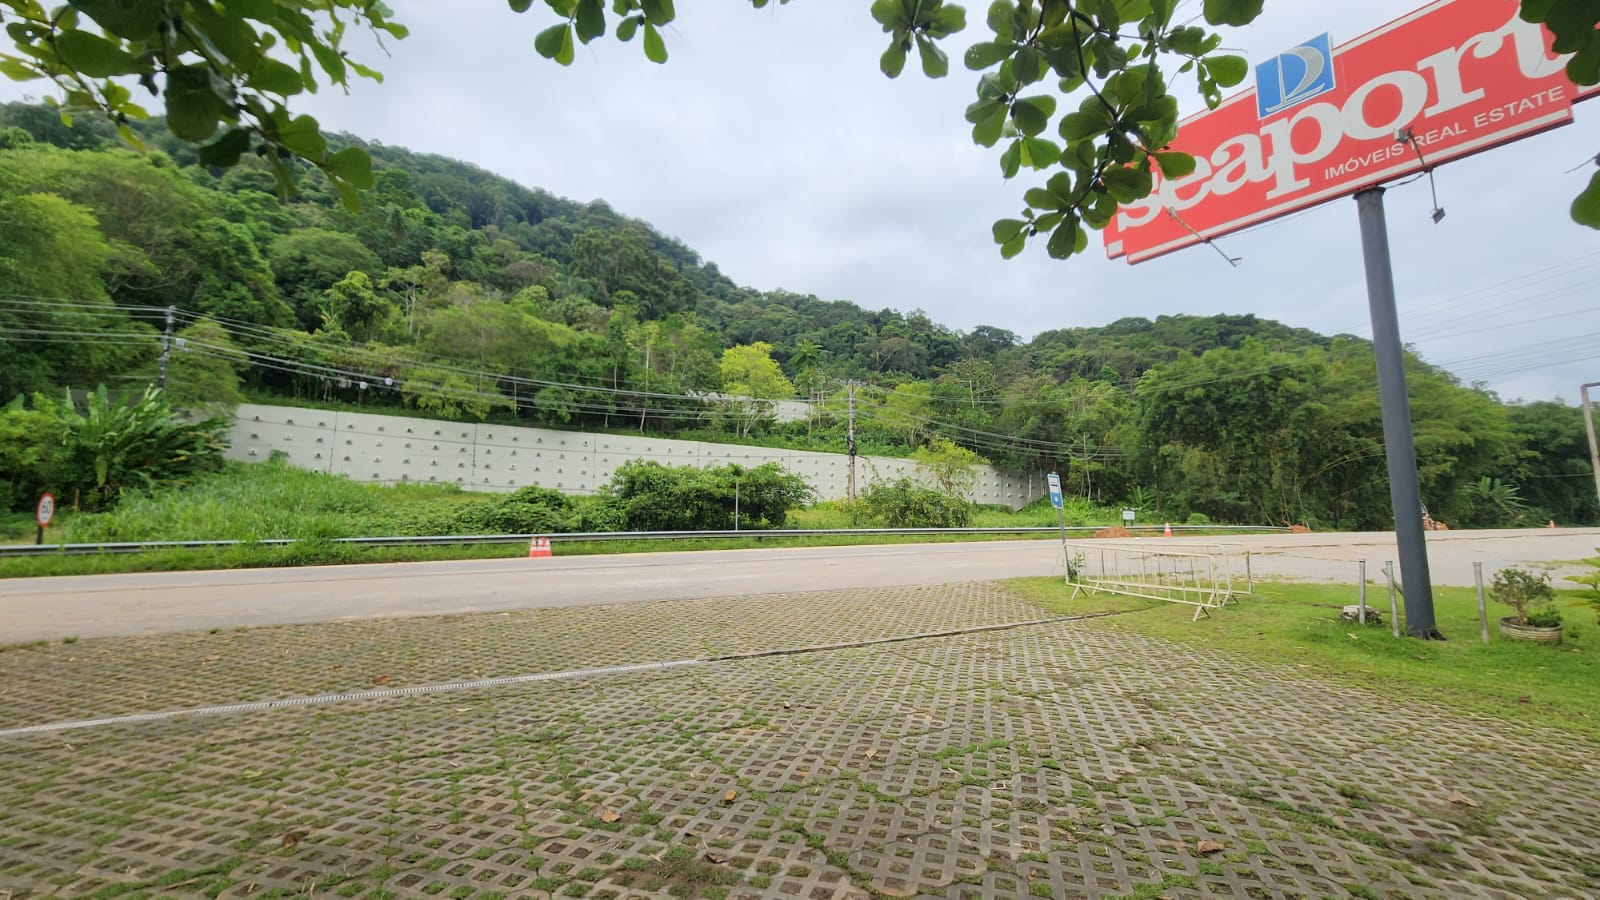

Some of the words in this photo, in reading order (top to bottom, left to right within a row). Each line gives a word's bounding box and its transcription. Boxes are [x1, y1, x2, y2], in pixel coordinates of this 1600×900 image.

[1324, 142, 1405, 180] IMÓVEIS
[1411, 121, 1468, 150] REAL
[1473, 85, 1566, 129] ESTATE
[41, 500, 52, 514] 60
